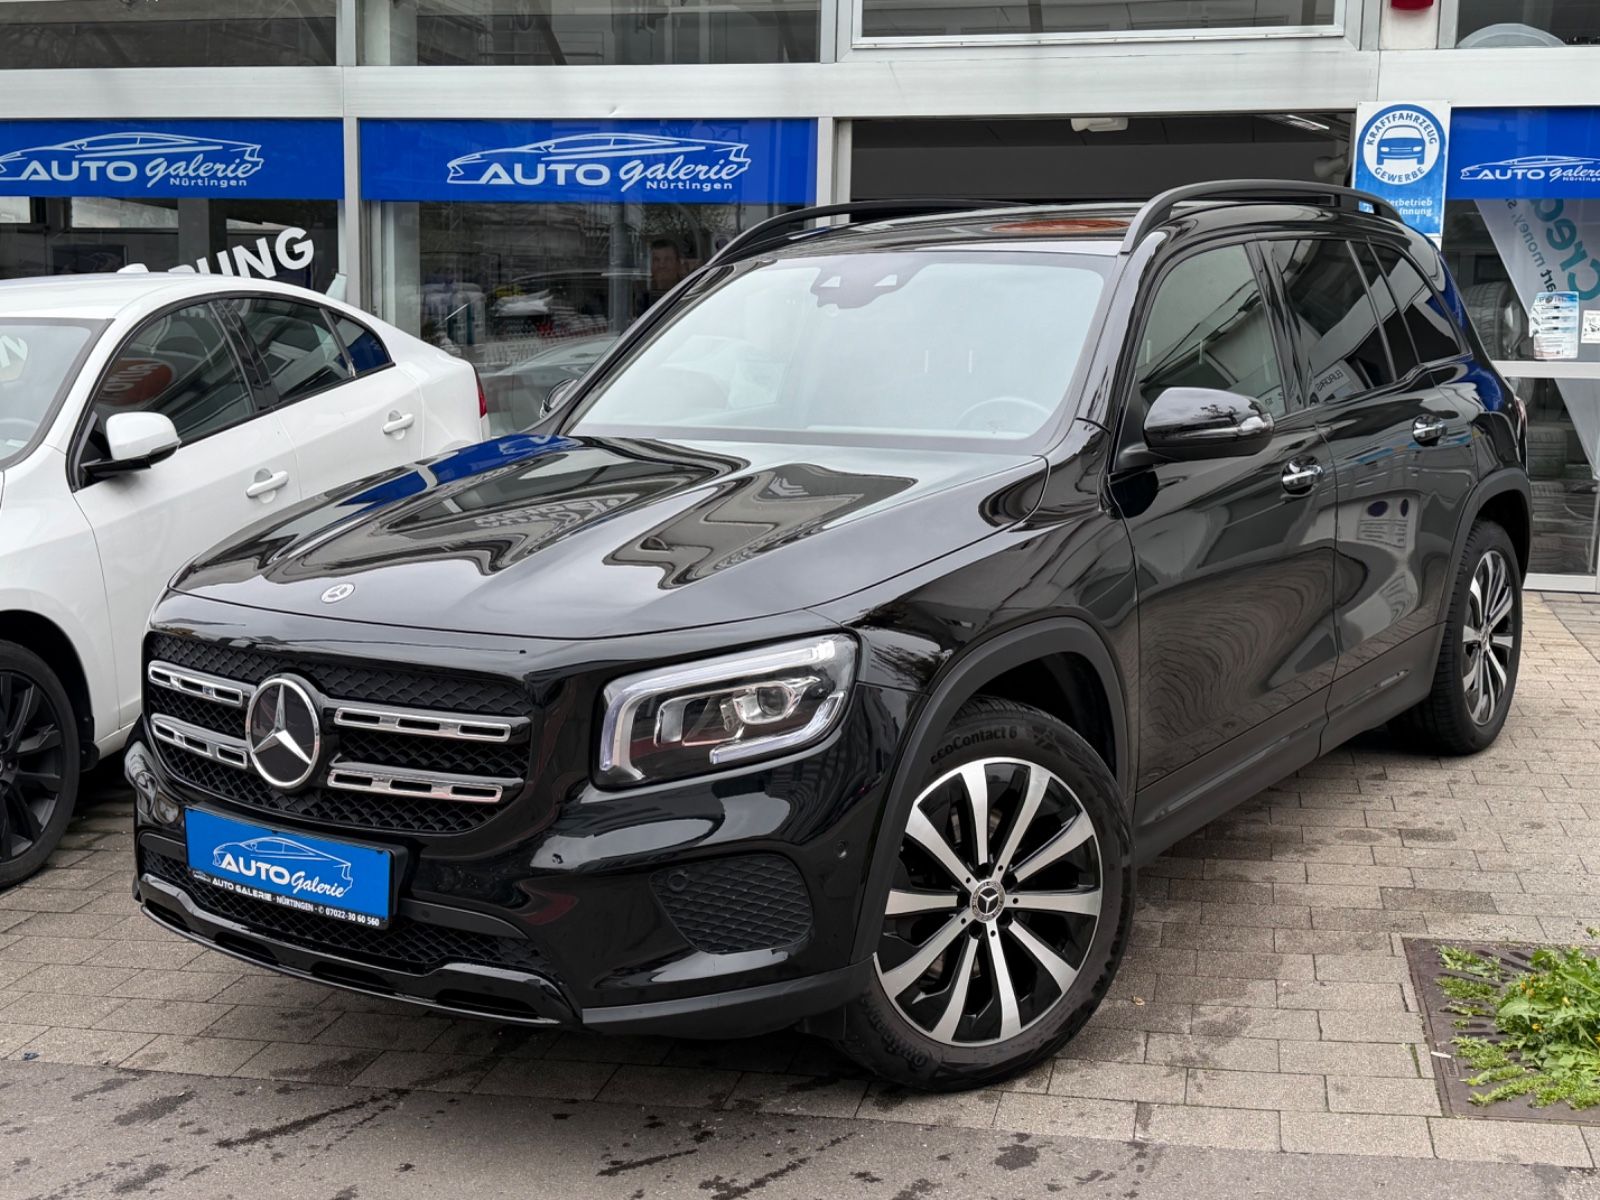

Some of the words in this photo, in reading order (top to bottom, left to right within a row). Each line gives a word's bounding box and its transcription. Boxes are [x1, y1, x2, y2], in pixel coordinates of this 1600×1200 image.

[1366, 112, 1437, 146] KRAFTFAHRZEUG
[20, 160, 138, 183] AUTO
[145, 153, 252, 189] galerie
[170, 177, 248, 188] Nürtingen
[479, 162, 611, 187] AUTO
[619, 155, 740, 192] galerie
[1374, 166, 1425, 183] GEWERBE
[1477, 168, 1545, 180] AUTO
[646, 181, 734, 192] Nürtingen
[1008, 725, 1018, 739] 6
[220, 853, 291, 885] AUTO
[291, 871, 345, 898] Galerie
[212, 877, 234, 891] AUTO
[235, 884, 272, 901] GALERIE
[276, 895, 314, 912] NÜRTINGEN
[357, 914, 366, 924] 60
[367, 917, 380, 927] 560
